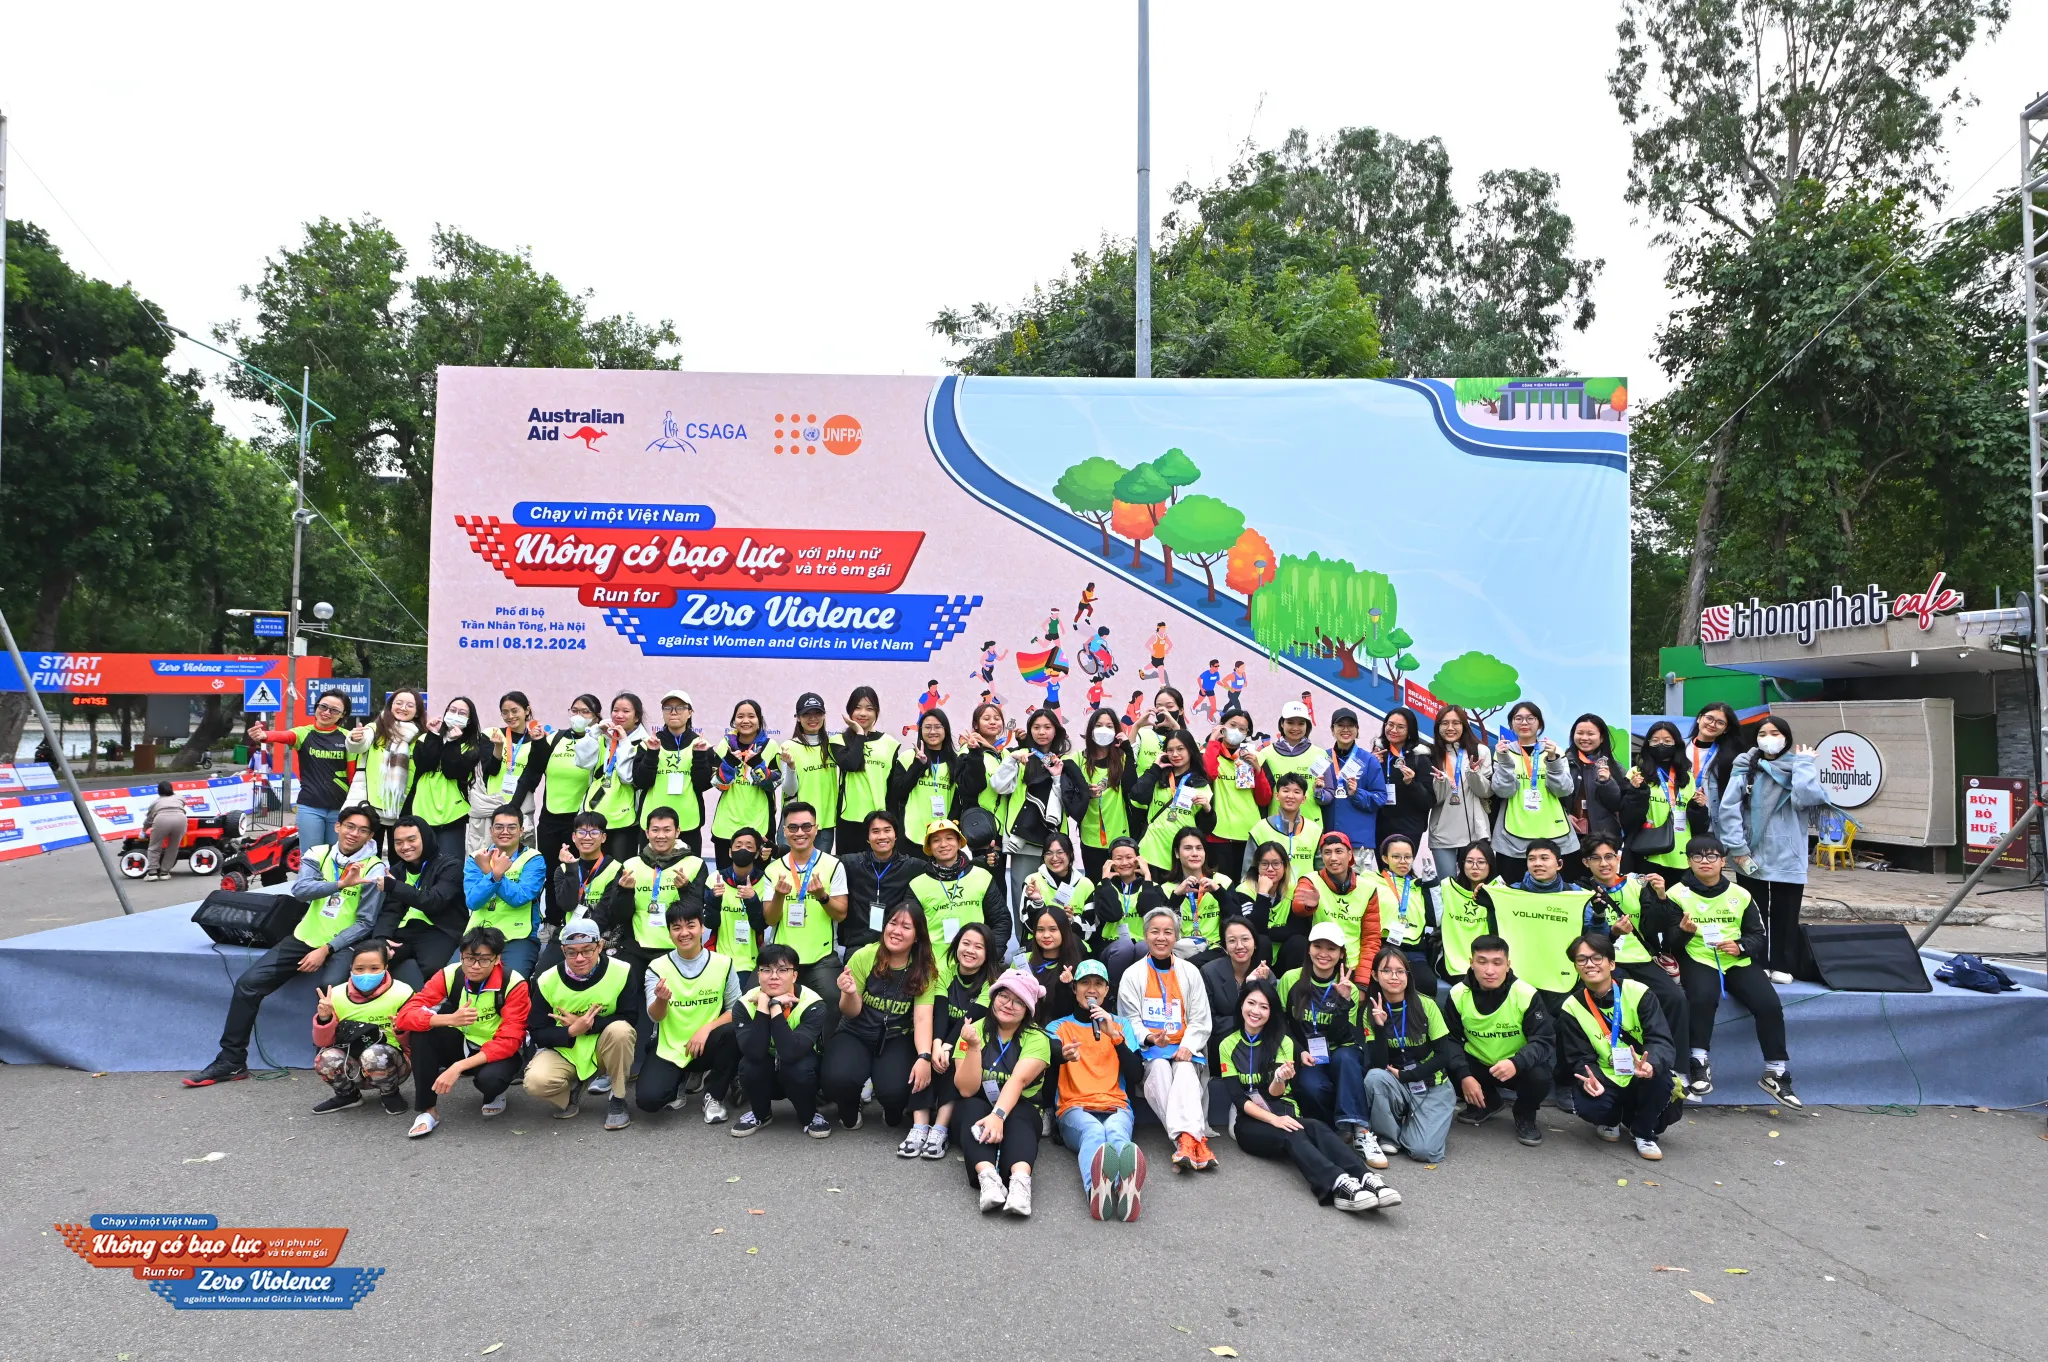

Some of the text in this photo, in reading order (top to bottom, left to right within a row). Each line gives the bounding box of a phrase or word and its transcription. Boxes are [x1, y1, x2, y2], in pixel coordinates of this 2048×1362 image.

[527, 407, 625, 425] Australian
[527, 426, 559, 441] Aid
[686, 423, 748, 440] CSAGA
[822, 427, 864, 442] UNFPA
[530, 506, 700, 524] Chạy vì một Việt Nam
[513, 532, 786, 575] Không có bạo lực
[797, 546, 882, 561] với phụ nữ
[795, 561, 892, 578] và trẻ em gái
[592, 586, 660, 603] Run for
[495, 605, 545, 618] Phố đi bộ
[680, 593, 897, 630] Zero Violence
[1734, 571, 1960, 645] thongnhat cafe
[461, 619, 586, 632] Trần Nhân Tông, Hà Nội
[458, 637, 587, 650] 6 am 08.12.2024
[657, 635, 914, 651] against Women and Girls in Viet Nam
[38, 655, 102, 670] START
[158, 662, 222, 673] Zero Violence
[31, 671, 102, 686] FINISH
[1820, 768, 1872, 790] thongnhat
[1969, 794, 1998, 805] BÚN
[1975, 808, 1992, 818] BÒ
[1970, 822, 1998, 834] HUẾ
[1512, 911, 1569, 923] VOLUNTEER
[668, 997, 718, 1007] VOLUNTEER
